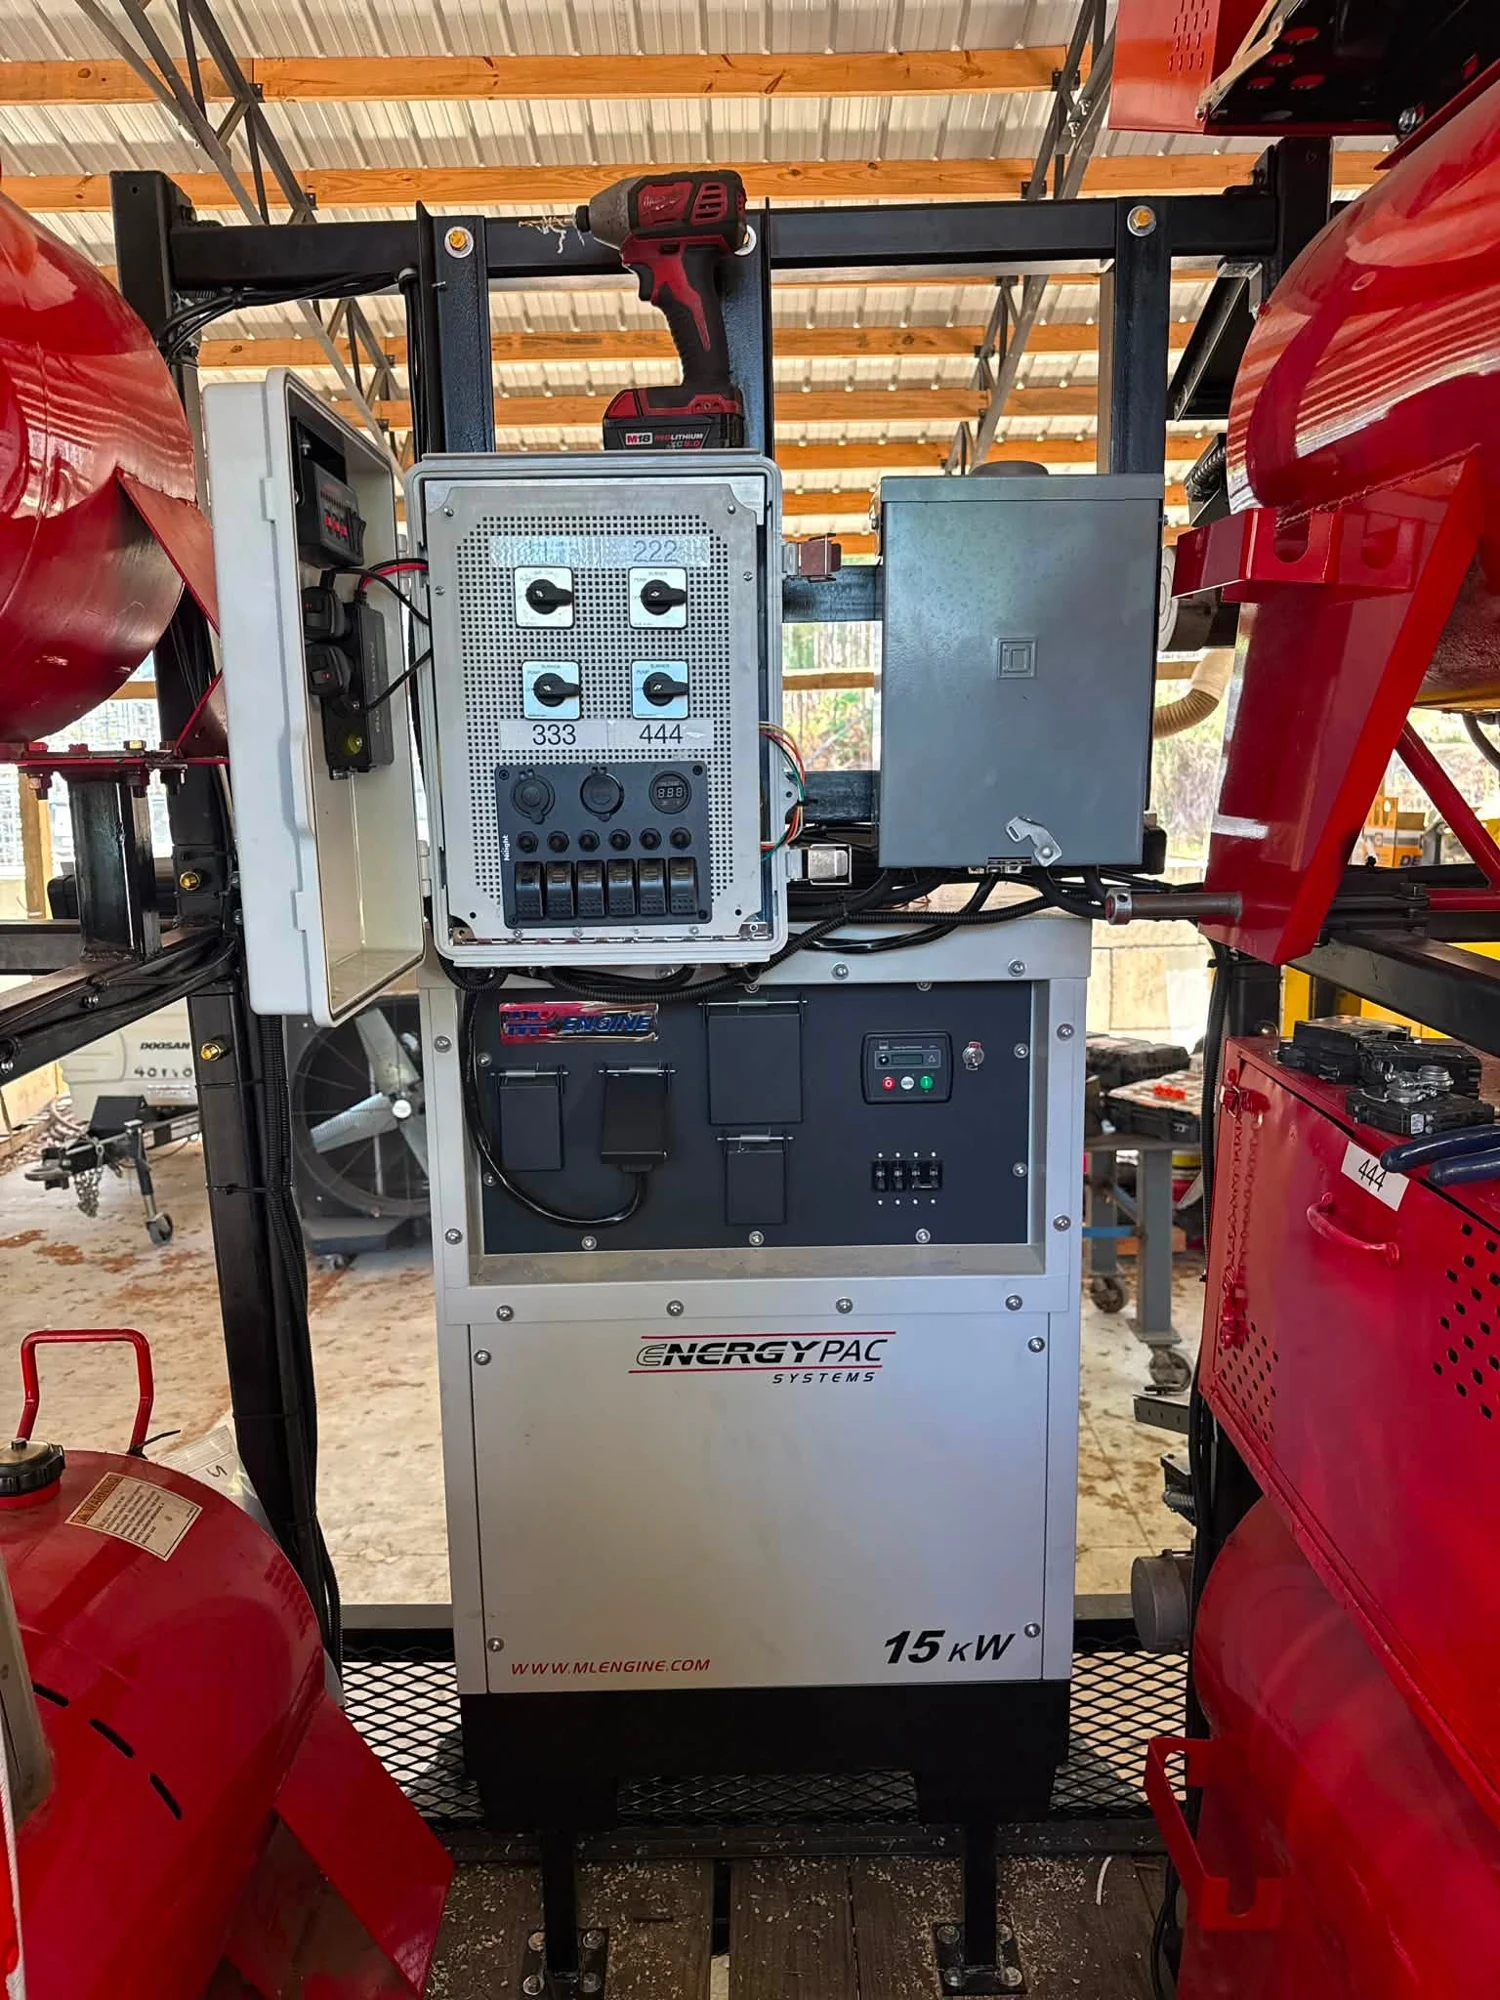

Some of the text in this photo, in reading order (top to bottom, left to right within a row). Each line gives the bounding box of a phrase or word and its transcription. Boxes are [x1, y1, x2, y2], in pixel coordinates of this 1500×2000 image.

[627, 433, 651, 444] M18
[633, 540, 679, 563] 222
[532, 723, 684, 746] 333 444
[562, 1015, 653, 1033] ENGINE
[140, 1041, 190, 1050] DOOSAN
[1358, 1158, 1387, 1193] 444
[772, 1371, 876, 1384] SYSTEMS
[86, 1475, 122, 1517] WARNING
[884, 1629, 946, 1665] 15
[511, 1659, 711, 1675] WWW.MLENGINE.COM
